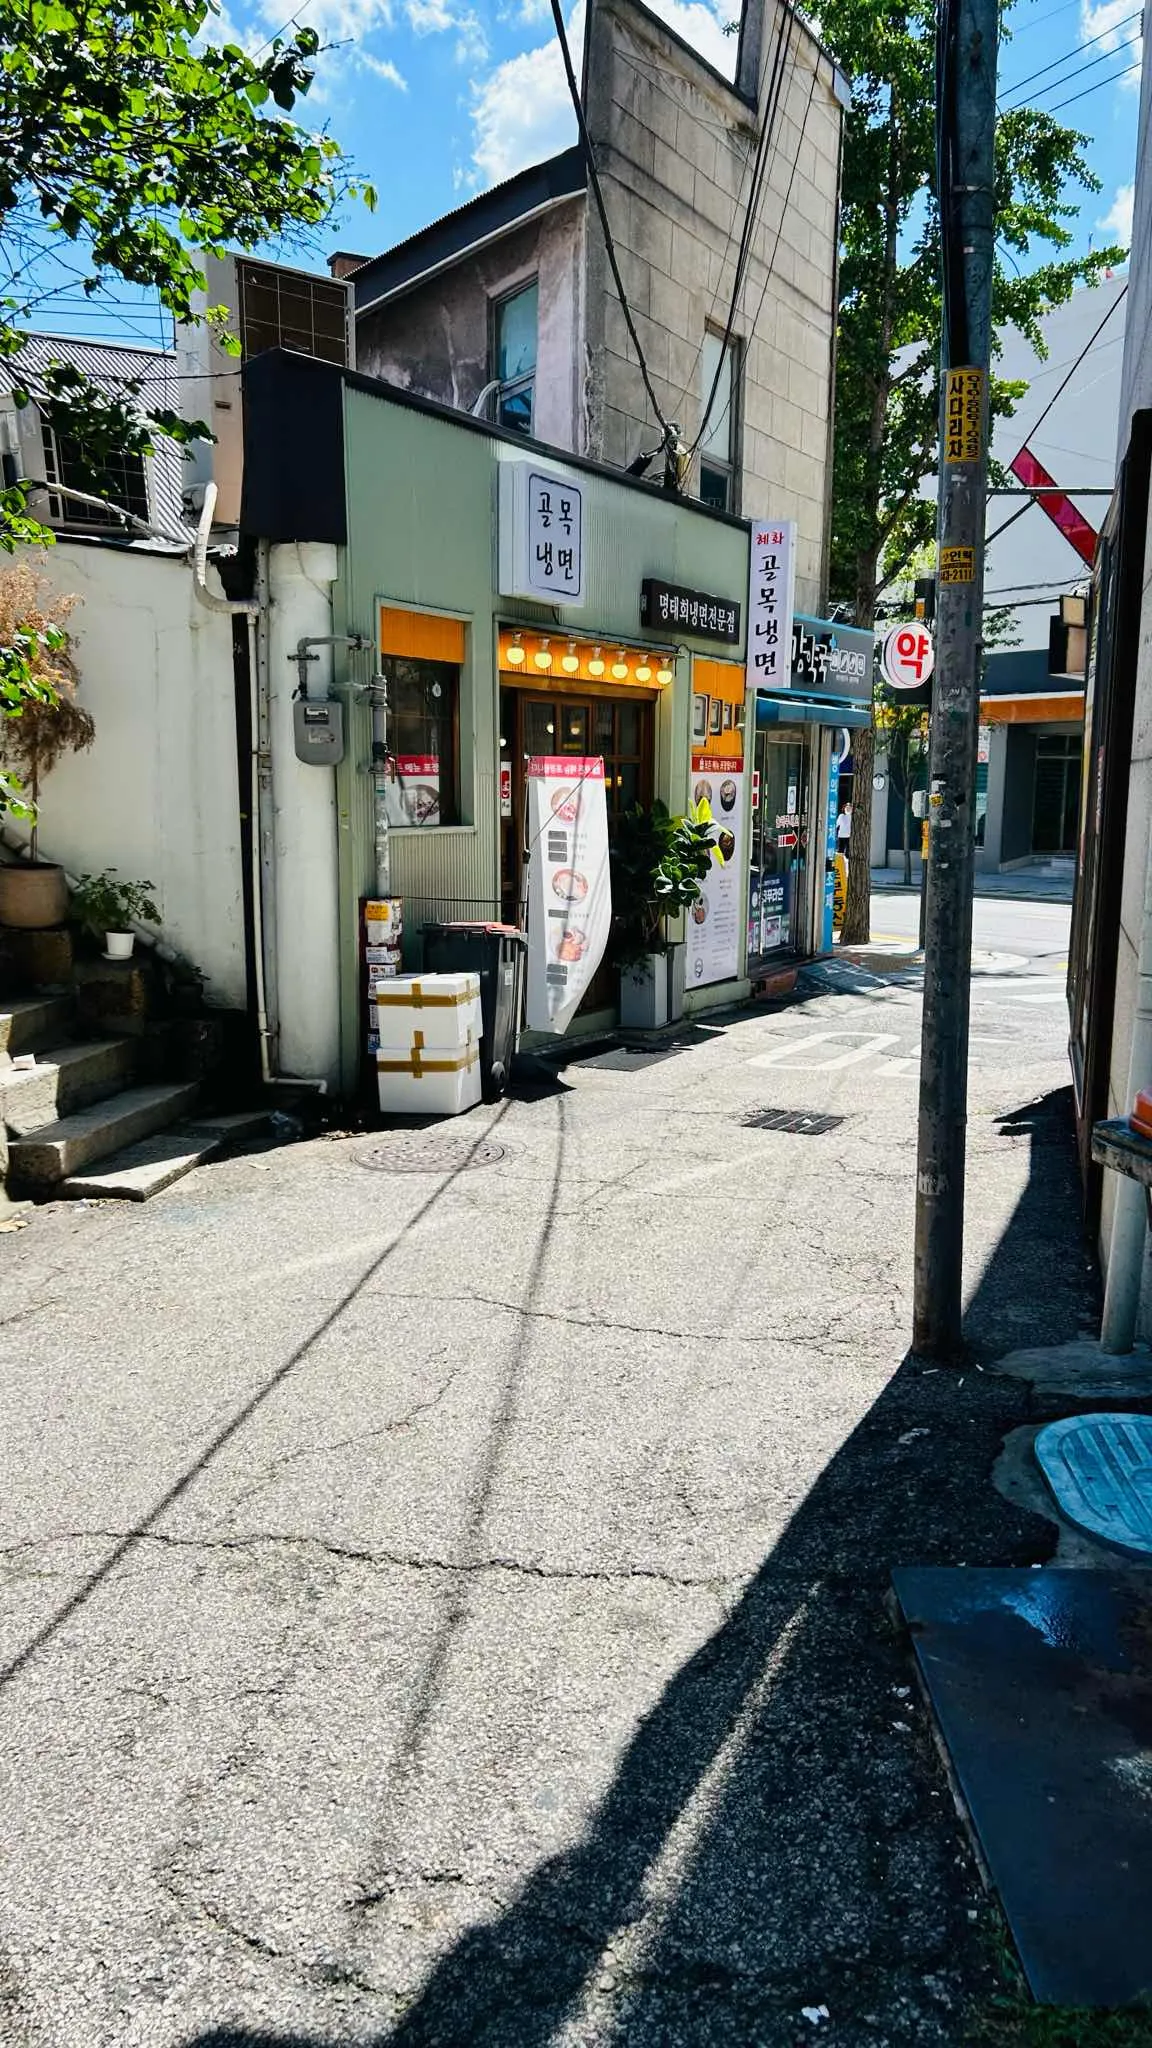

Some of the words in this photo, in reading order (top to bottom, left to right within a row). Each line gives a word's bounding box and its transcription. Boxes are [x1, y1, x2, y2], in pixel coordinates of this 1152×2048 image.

[948, 375, 964, 458] 사다리차
[537, 491, 574, 536] 골목
[536, 541, 574, 581] 냉면
[755, 531, 785, 546] 혜화
[658, 592, 735, 634] 명태회냉면전문점
[754, 554, 781, 676] 골목냉면
[897, 632, 930, 680] 약
